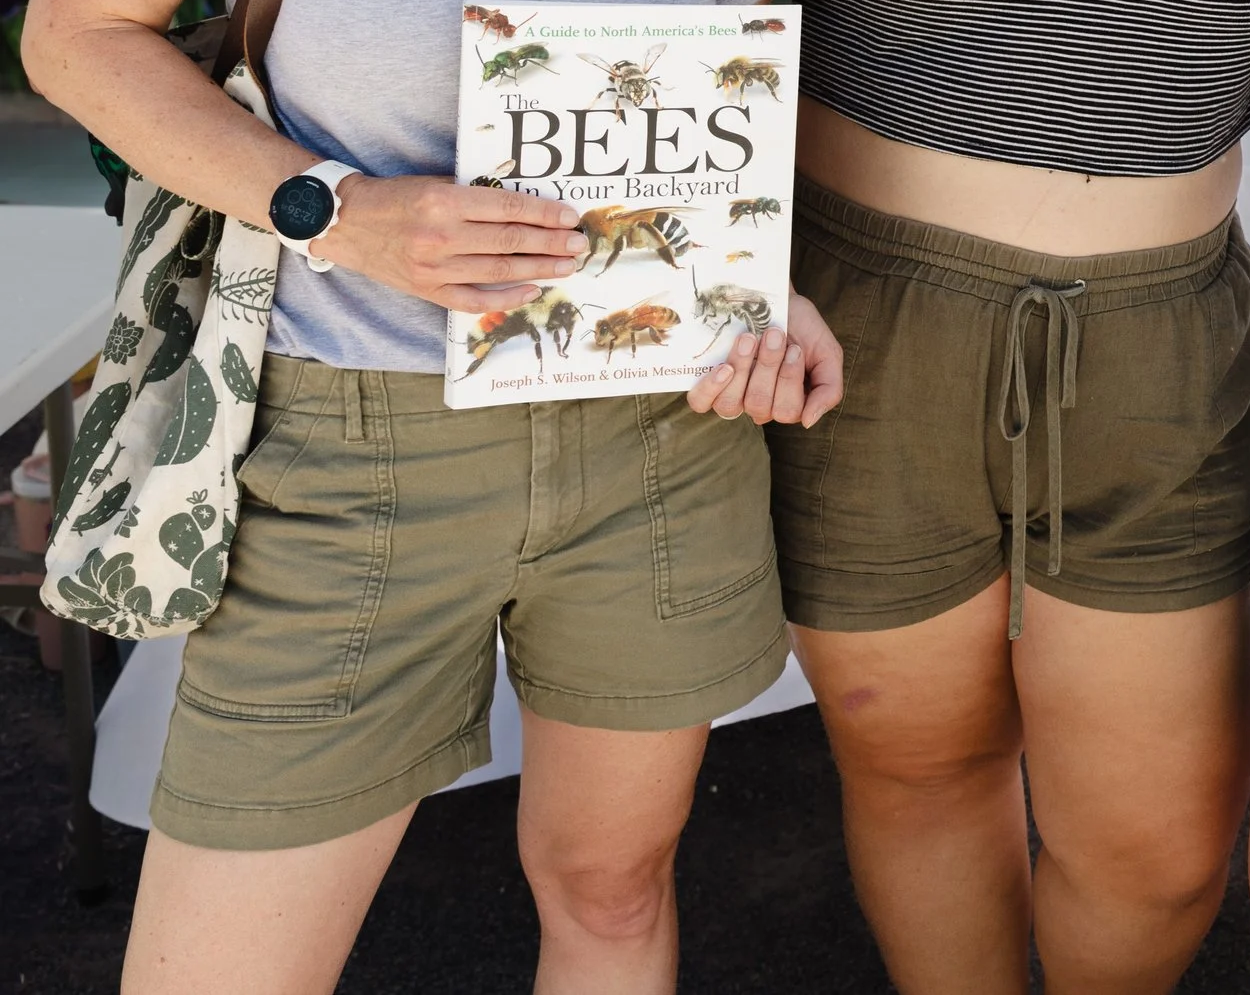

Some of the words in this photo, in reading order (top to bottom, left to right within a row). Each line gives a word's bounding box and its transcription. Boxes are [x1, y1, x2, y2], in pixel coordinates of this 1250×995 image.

[525, 26, 535, 37] A
[540, 25, 580, 38] Guide
[584, 27, 597, 37] to
[601, 24, 638, 37] North
[641, 24, 704, 37] America's
[709, 25, 737, 36] Bees
[500, 94, 540, 110] The
[500, 105, 754, 179] BEES
[552, 180, 615, 201] Your
[624, 174, 740, 203] Backyard
[490, 376, 533, 392] Joseph
[537, 375, 549, 386] S.
[553, 373, 595, 385] Wilson
[599, 371, 609, 382] &
[613, 367, 648, 380] Olivia
[652, 363, 714, 378] Messinger
